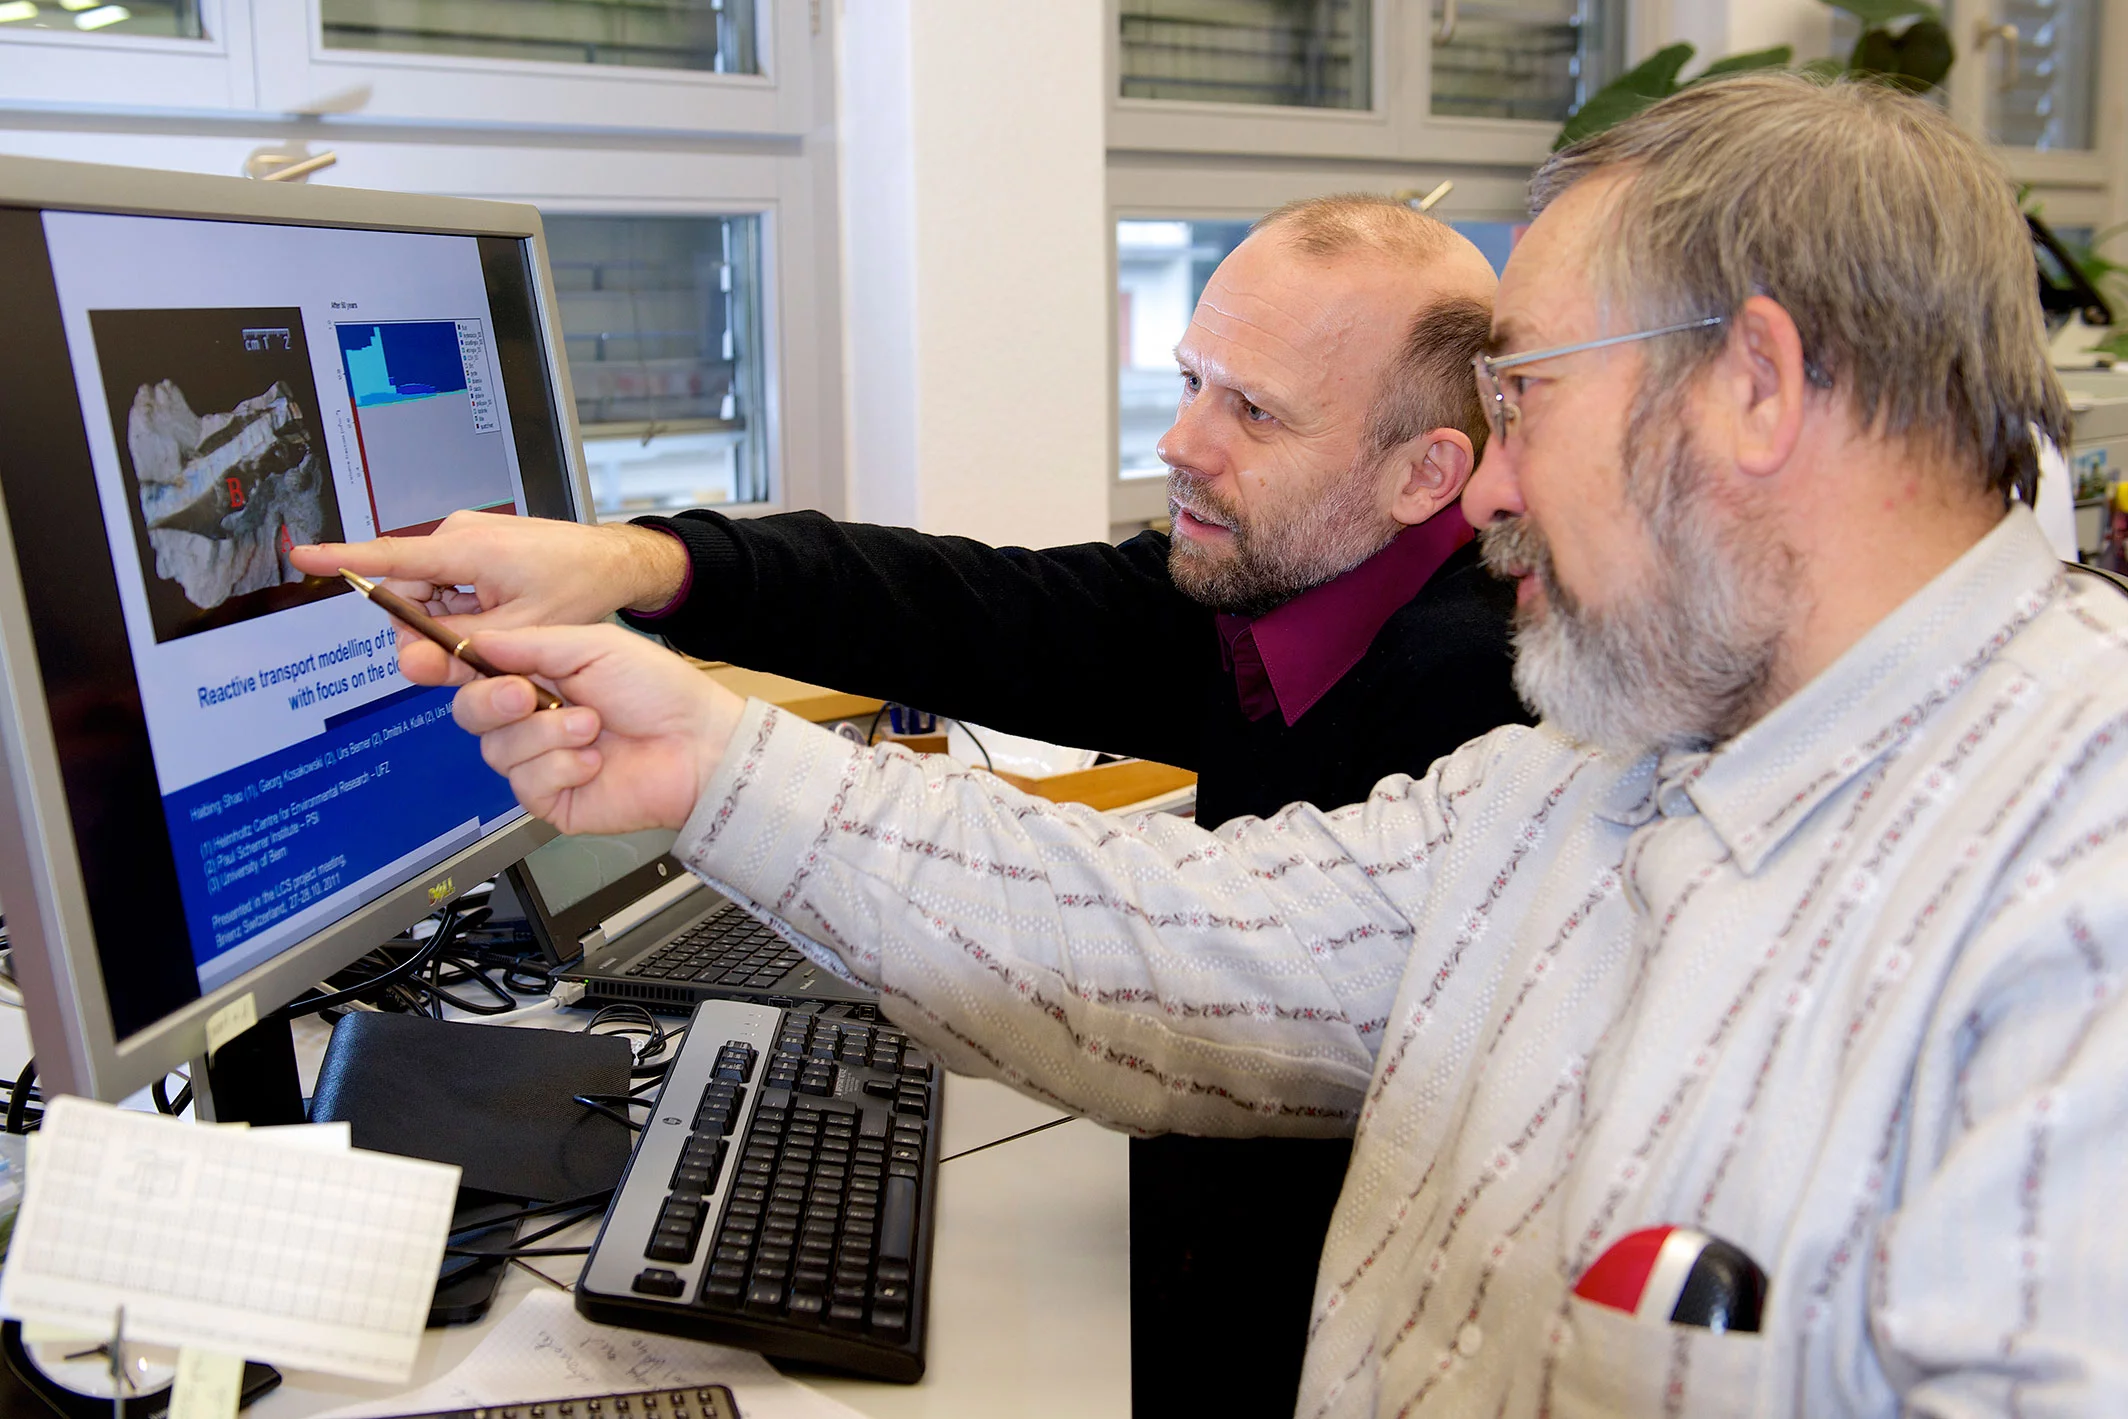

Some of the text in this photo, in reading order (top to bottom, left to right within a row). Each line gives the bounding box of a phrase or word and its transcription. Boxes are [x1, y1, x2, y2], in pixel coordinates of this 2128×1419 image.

[245, 335, 291, 351] cm 1 2
[226, 477, 245, 508] B
[281, 524, 295, 553] A
[197, 676, 256, 709] Reactive
[258, 654, 317, 688] transport
[318, 638, 373, 669] modelling
[375, 629, 385, 650] of
[288, 687, 316, 711] with
[316, 675, 349, 702] focus
[351, 672, 366, 688] on
[367, 663, 386, 683] the
[222, 791, 244, 809] Shao
[258, 775, 283, 793] Georg
[283, 756, 324, 783] Kosakowski
[336, 746, 350, 760] Urs
[349, 738, 371, 755] Berner
[410, 713, 425, 729] Kulik
[435, 706, 446, 719] Urs
[213, 824, 253, 851] Helmholtz
[253, 813, 279, 832] Centre
[279, 807, 290, 820] for
[290, 783, 339, 817] Environmental
[338, 771, 370, 794] Research
[375, 760, 391, 777] UFZ
[204, 858, 216, 878] (2)
[216, 850, 236, 868] Paul
[236, 836, 270, 860] Scherrer
[270, 823, 300, 844] Institute
[305, 811, 320, 827] PSI
[208, 846, 288, 896] (3) University of Bern
[323, 872, 341, 891] 2011
[428, 876, 456, 907] DELL
[212, 900, 252, 930] Presented
[253, 896, 261, 908] in
[262, 889, 275, 904] the
[275, 878, 292, 897] LCS
[292, 867, 317, 891] project
